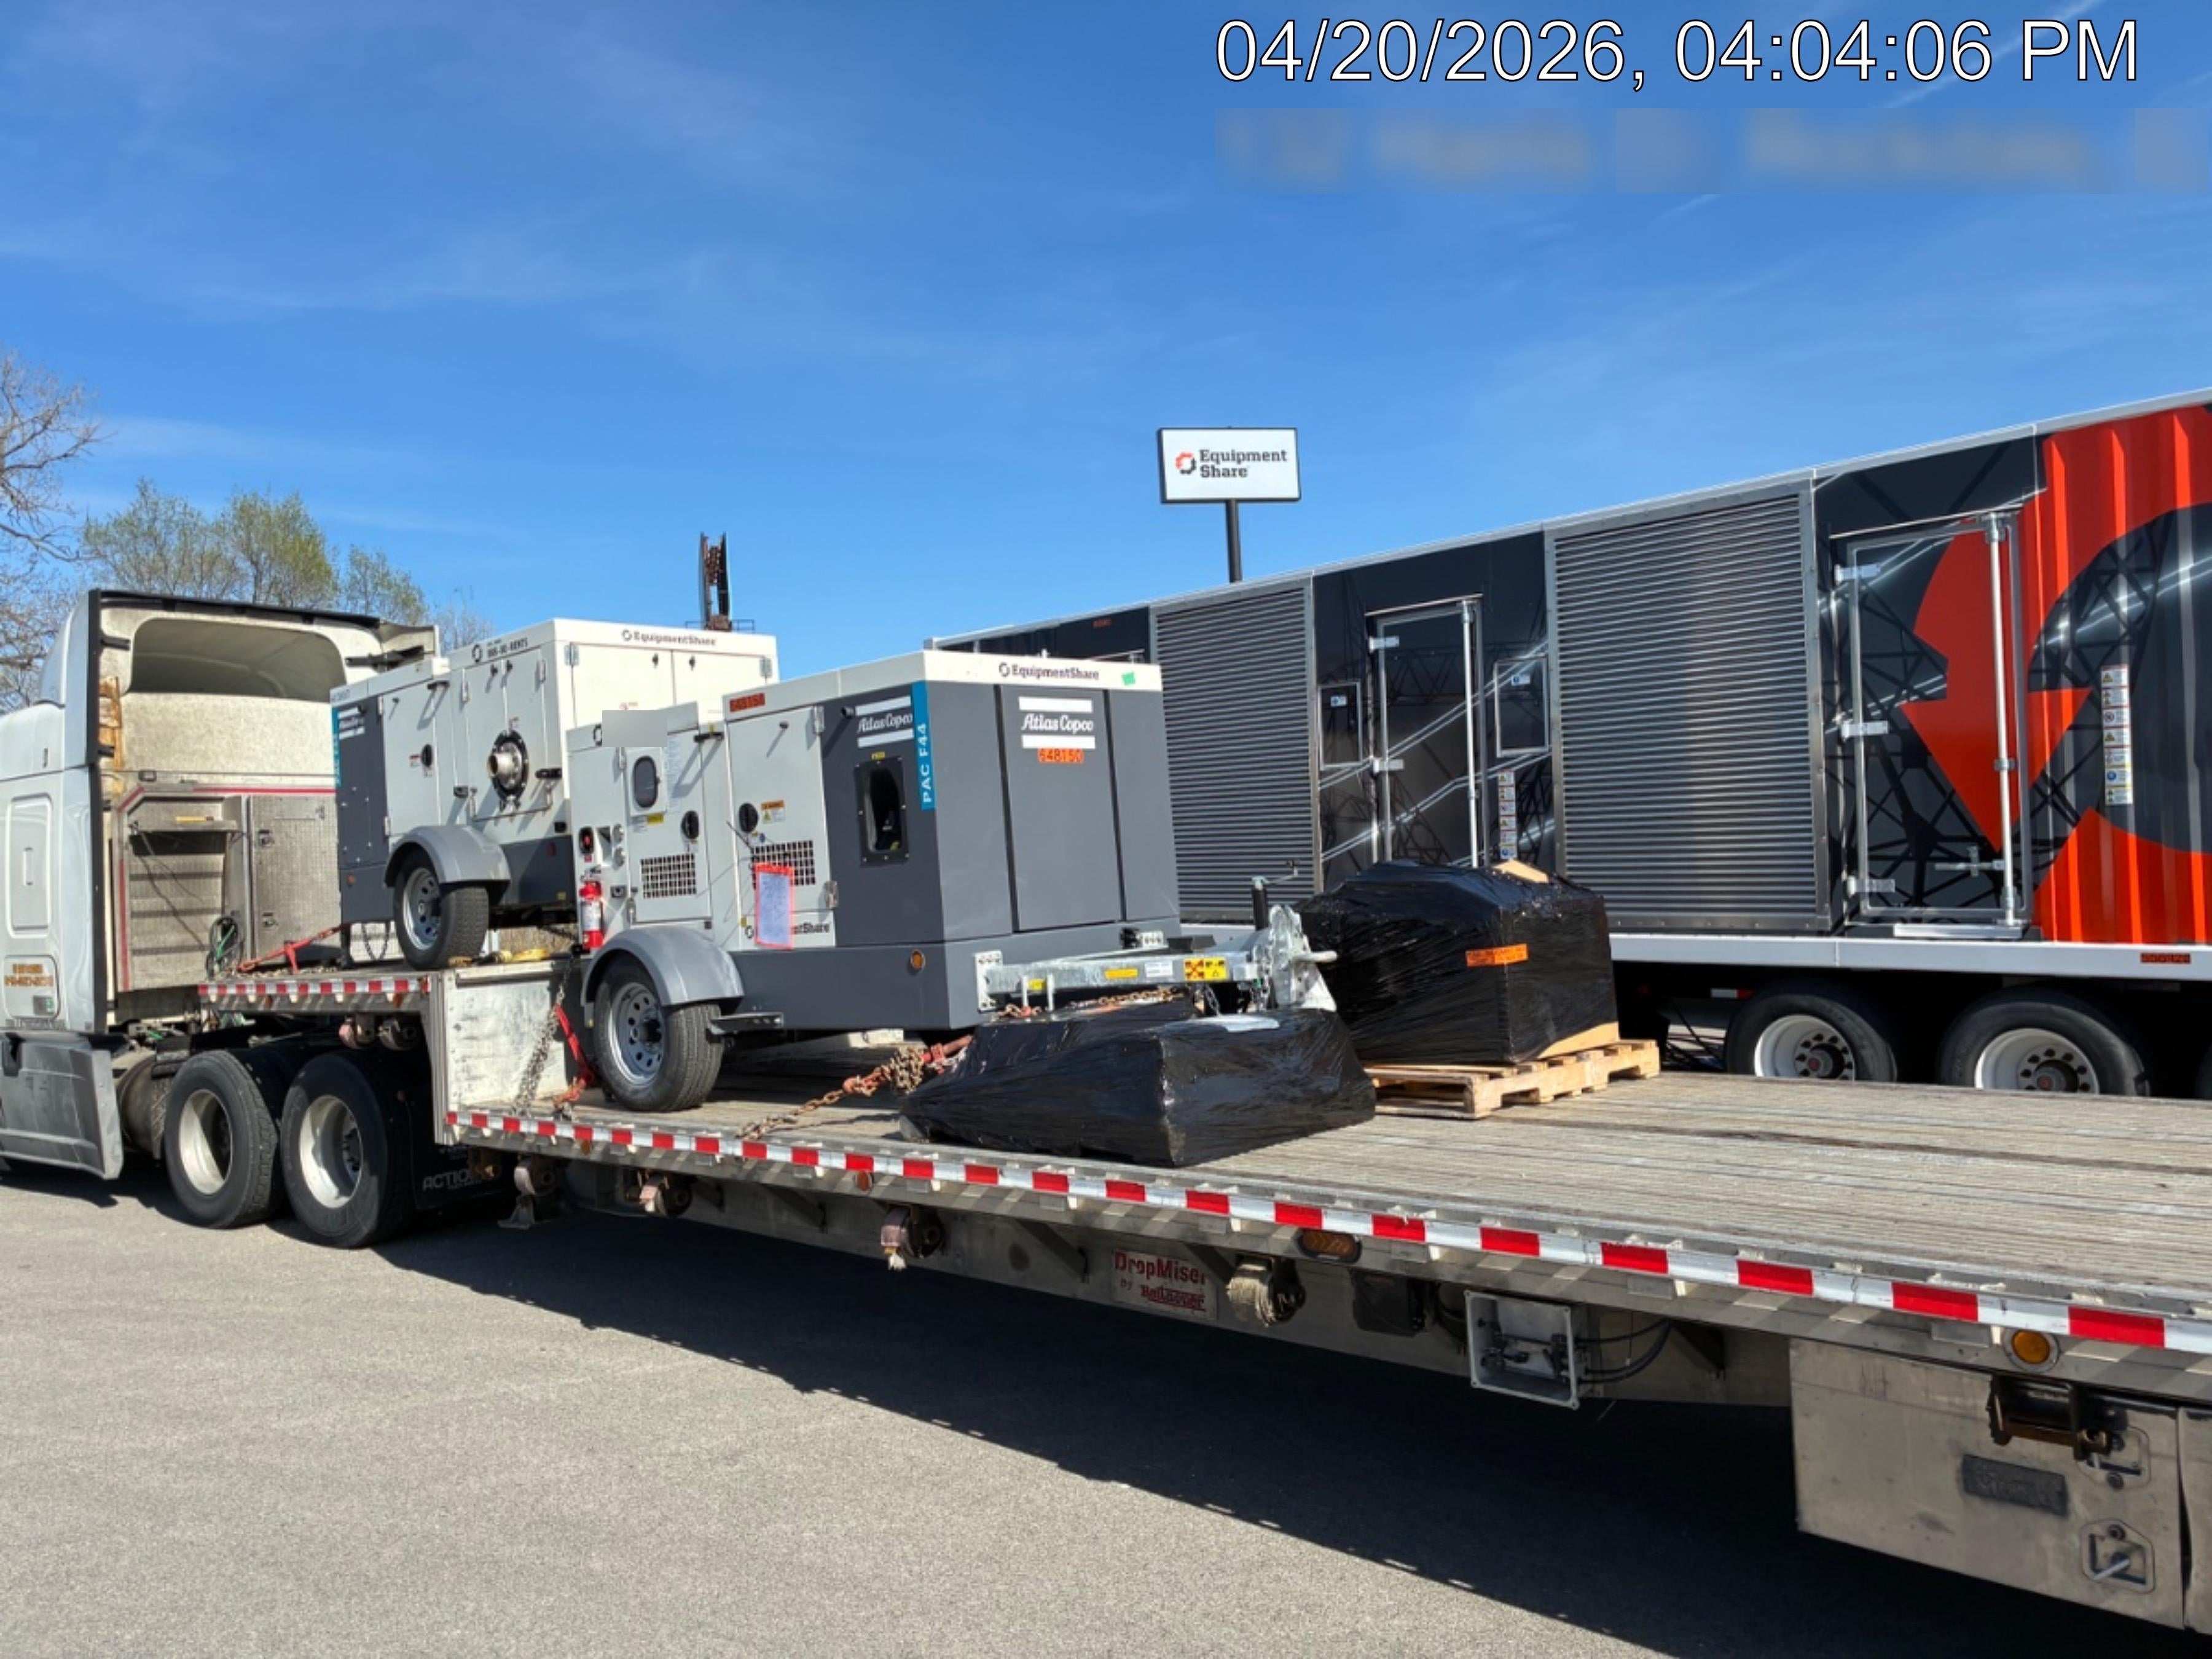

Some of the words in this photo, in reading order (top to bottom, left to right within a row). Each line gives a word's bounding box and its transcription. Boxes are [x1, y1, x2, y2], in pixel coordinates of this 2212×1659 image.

[1199, 449, 1287, 465] Equipment
[1200, 464, 1248, 478] Share
[1011, 665, 1100, 680] EquipmentShare
[857, 716, 885, 733] Atlas
[885, 713, 913, 729] Copco
[1021, 713, 1059, 732] Atlas
[1059, 715, 1094, 735] Copco
[917, 723, 929, 756] F44
[920, 764, 932, 802] PAC
[1115, 1251, 1206, 1285] DropMiser
